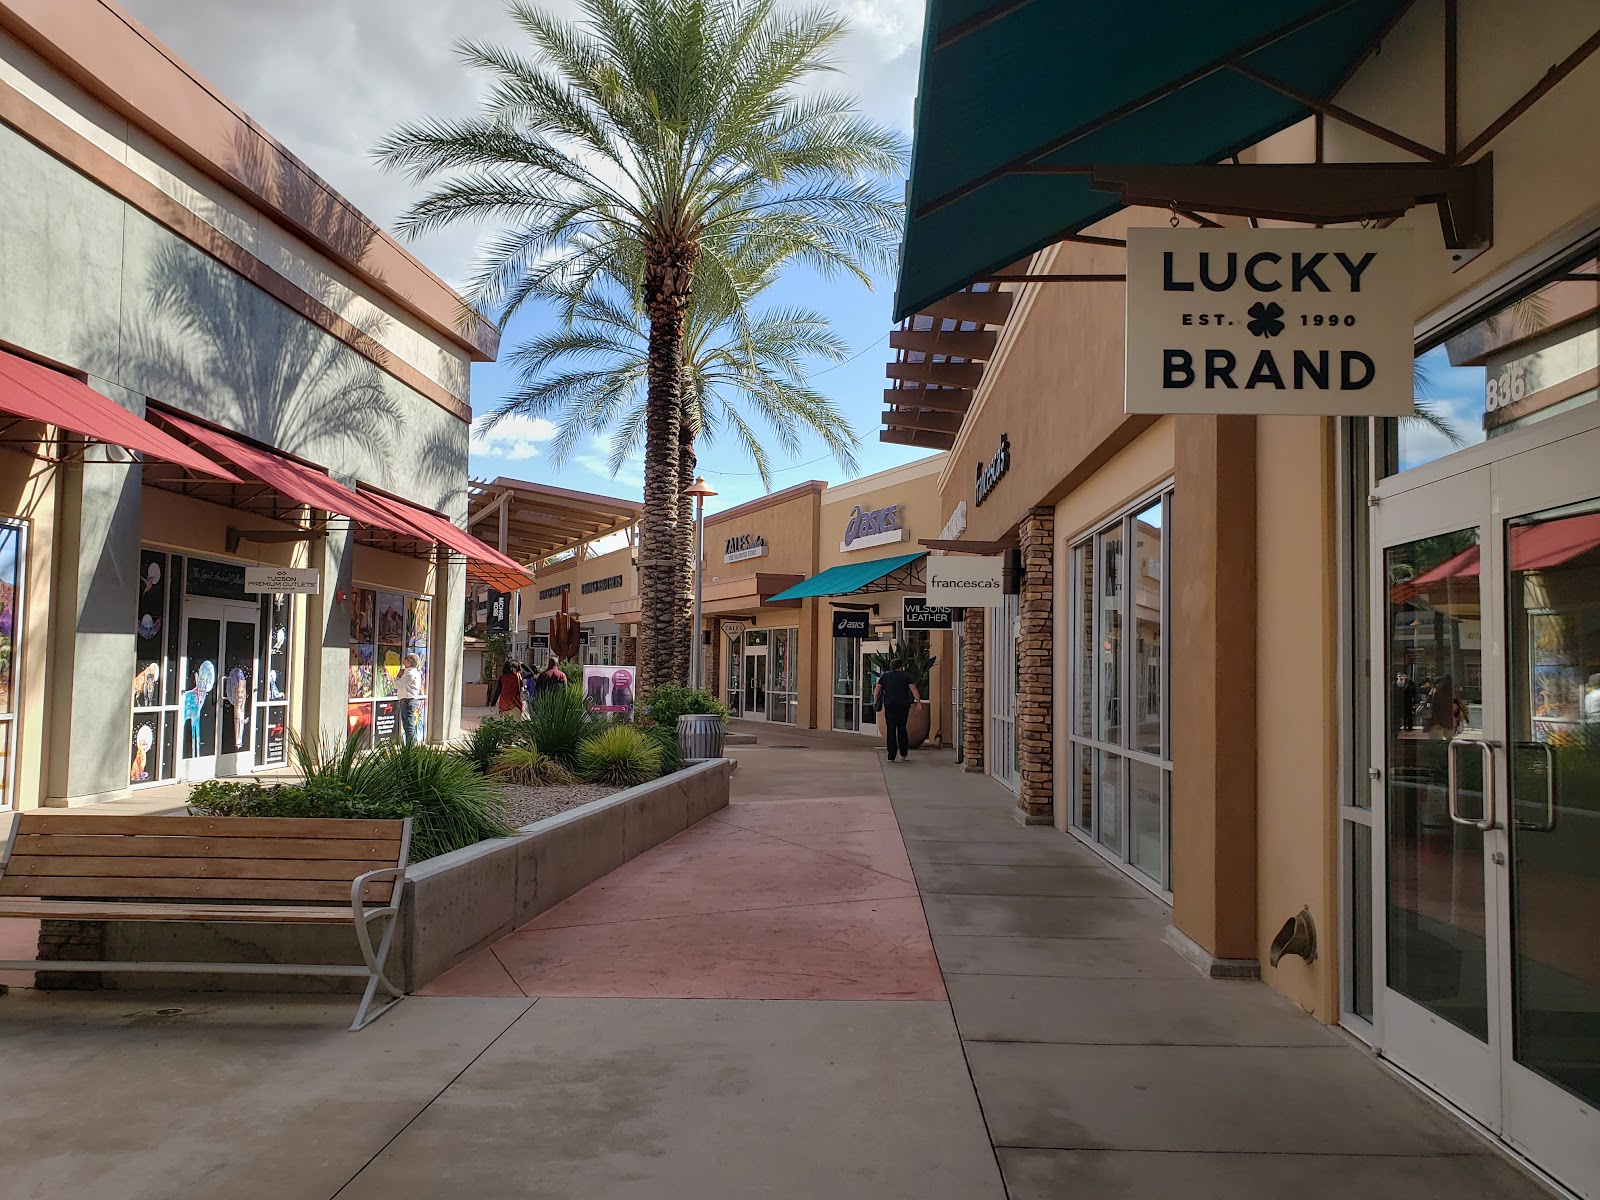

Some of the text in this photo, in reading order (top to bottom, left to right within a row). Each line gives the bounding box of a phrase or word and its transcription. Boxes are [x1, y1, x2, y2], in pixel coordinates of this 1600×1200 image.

[1163, 251, 1378, 293] LUCKY
[1182, 313, 1356, 327] EST. 1990
[1162, 348, 1376, 391] BRAND
[1485, 368, 1525, 413] 836
[725, 534, 751, 555] ZALES
[931, 575, 1000, 589] francesca's
[905, 604, 951, 613] WILSONS
[906, 613, 948, 622] LEATHER
